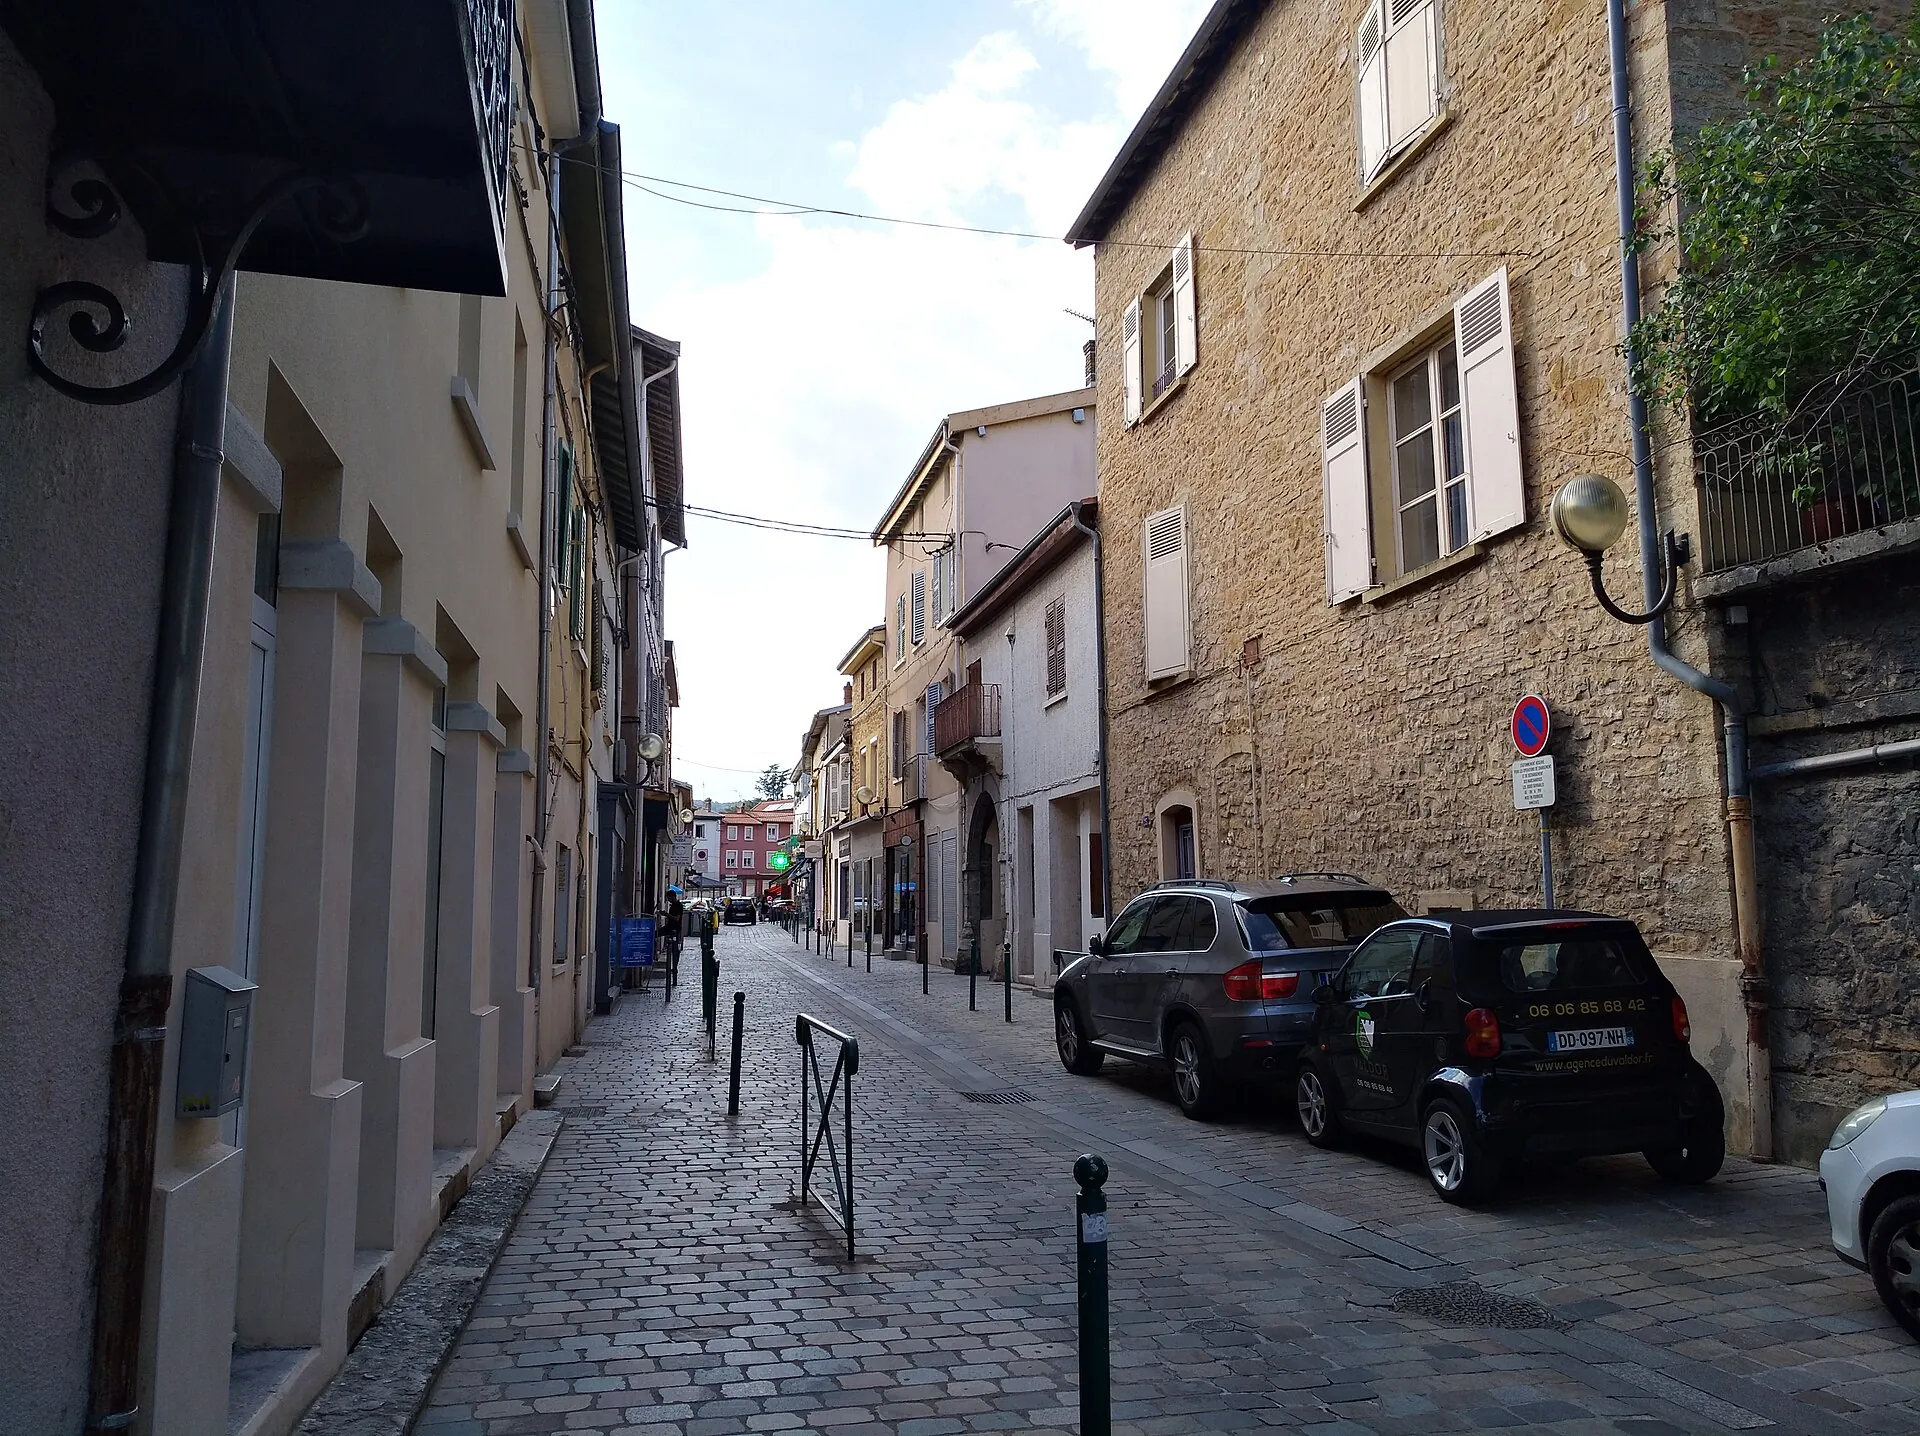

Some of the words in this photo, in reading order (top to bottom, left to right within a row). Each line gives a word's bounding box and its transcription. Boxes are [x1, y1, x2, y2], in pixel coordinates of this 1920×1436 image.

[1529, 1005, 1550, 1017] 06
[1555, 1003, 1575, 1015] 06
[1580, 1001, 1599, 1014] 85
[1603, 1000, 1622, 1012] 68
[1628, 999, 1646, 1011] 42
[1558, 1030, 1624, 1048] DD-097-NH
[1535, 1052, 1654, 1073] www.agenceduvaldor.fr
